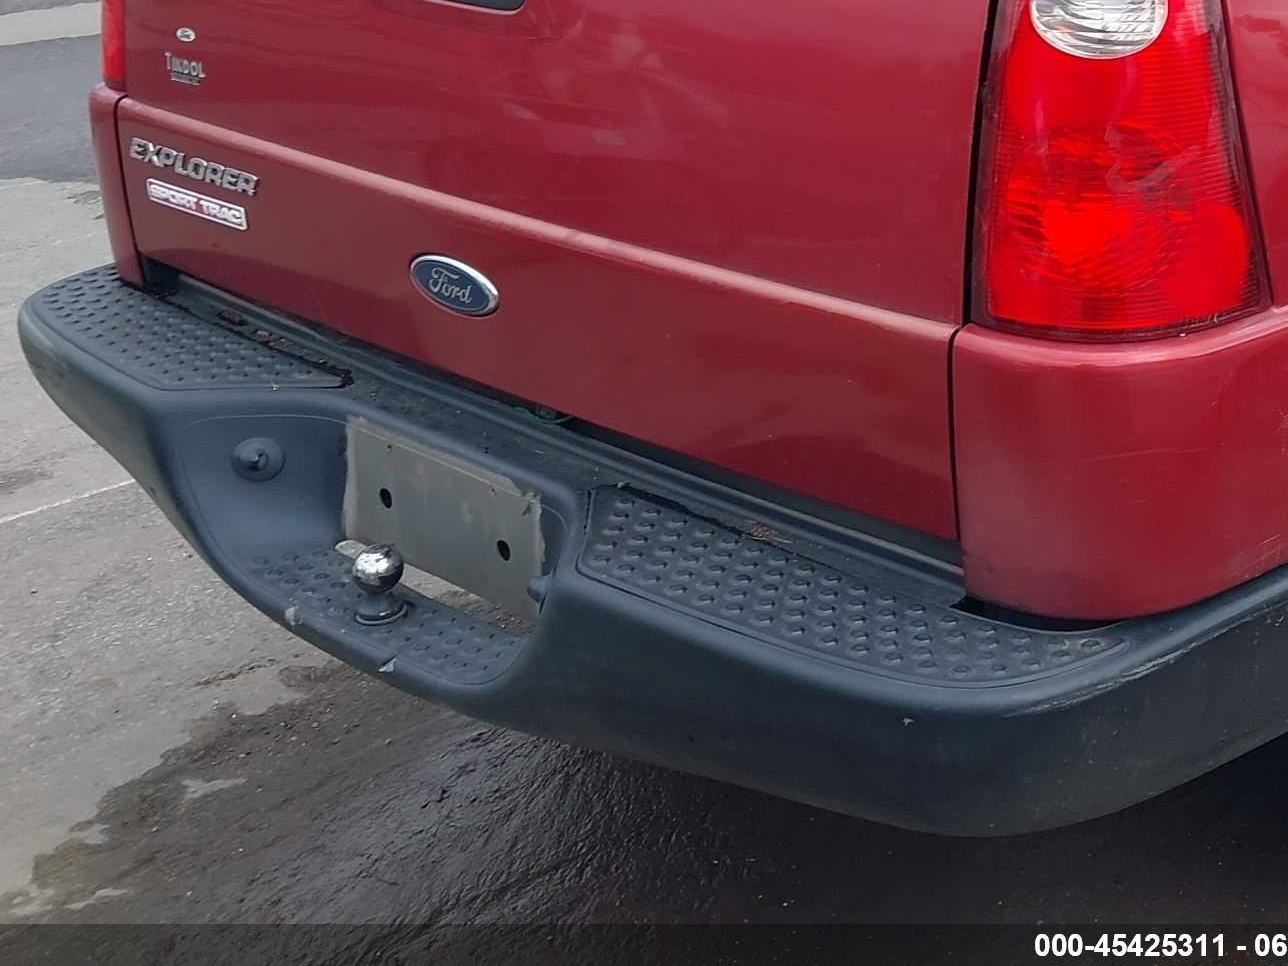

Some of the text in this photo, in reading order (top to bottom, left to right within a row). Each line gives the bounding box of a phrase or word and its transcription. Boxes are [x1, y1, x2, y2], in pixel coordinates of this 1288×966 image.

[129, 137, 259, 196] EXPLORER
[149, 184, 243, 225] SPORT TRAC
[428, 267, 473, 304] Ford
